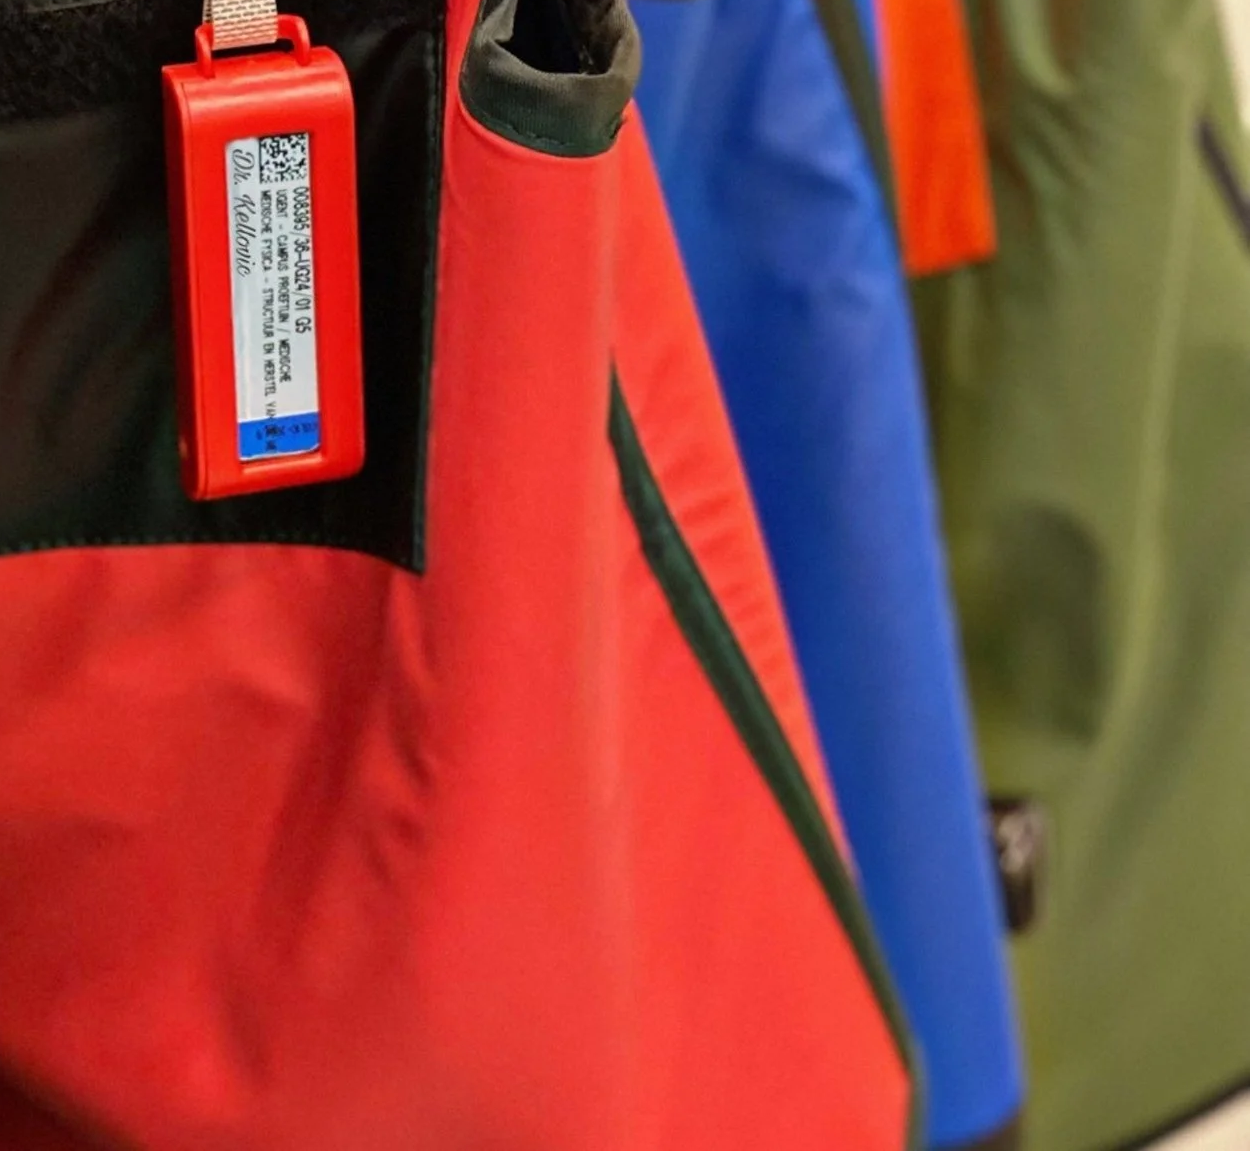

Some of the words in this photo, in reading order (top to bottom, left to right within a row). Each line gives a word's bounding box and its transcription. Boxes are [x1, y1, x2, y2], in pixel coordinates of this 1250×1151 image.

[232, 148, 255, 185] Dr.
[261, 190, 273, 234] MEDISCHE
[276, 189, 288, 218] UGENT
[233, 194, 256, 278] Kellovic
[261, 238, 273, 272] FYSICA
[277, 235, 289, 272] CAMPUS
[262, 288, 274, 338] STRUCTUUR
[278, 276, 290, 323] PROEFTUIN
[264, 359, 276, 396] HERSTEL
[278, 339, 291, 383] MEDISCHE
